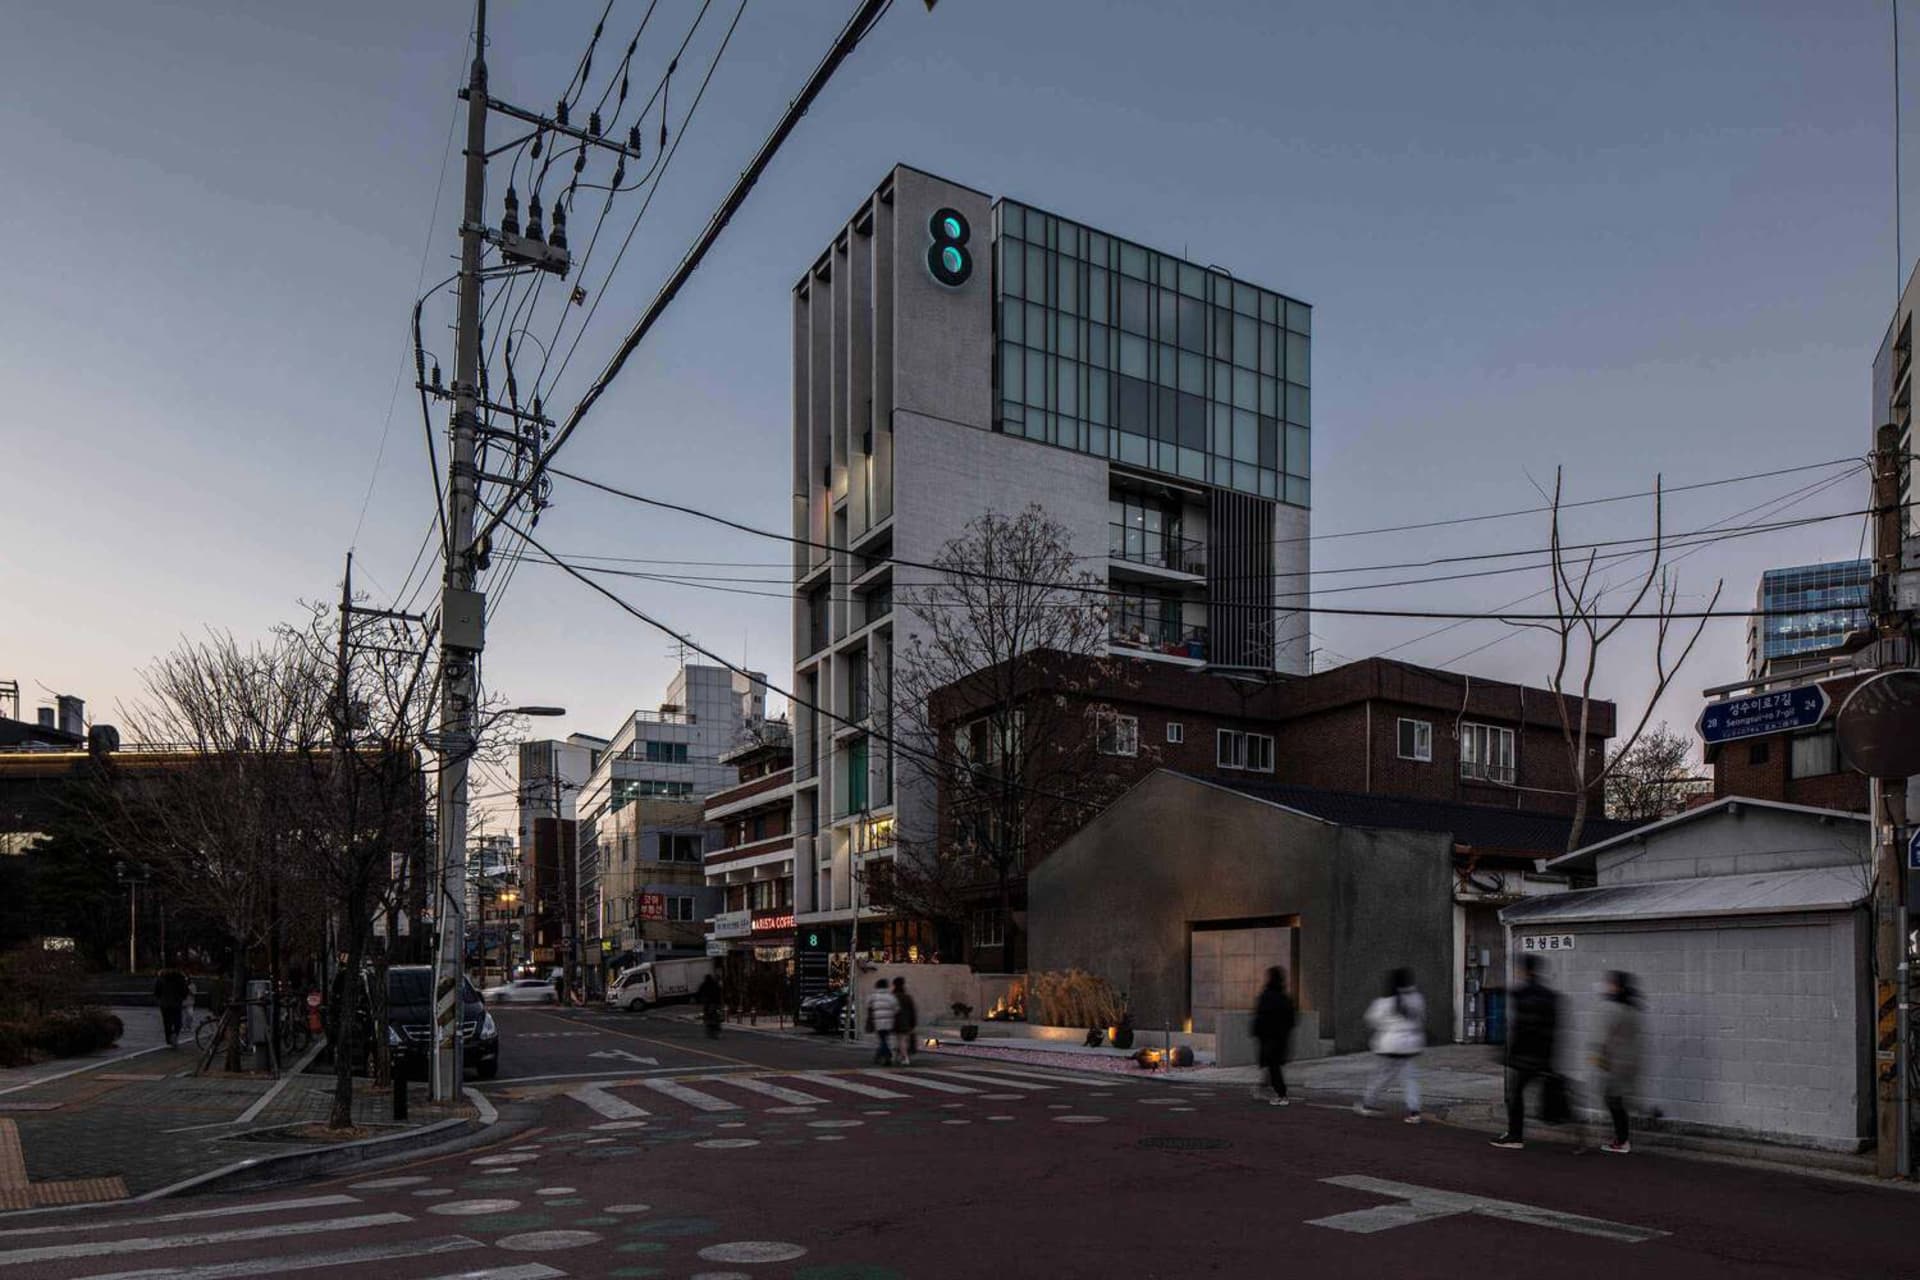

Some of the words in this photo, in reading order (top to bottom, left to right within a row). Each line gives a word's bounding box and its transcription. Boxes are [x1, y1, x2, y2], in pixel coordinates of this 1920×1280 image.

[927, 207, 973, 287] 8
[1729, 693, 1792, 716] 성수이로7길
[1805, 699, 1816, 710] 24
[1707, 719, 1718, 729] 28
[809, 934, 818, 946] 8
[1525, 936, 1573, 949] 화성금속
